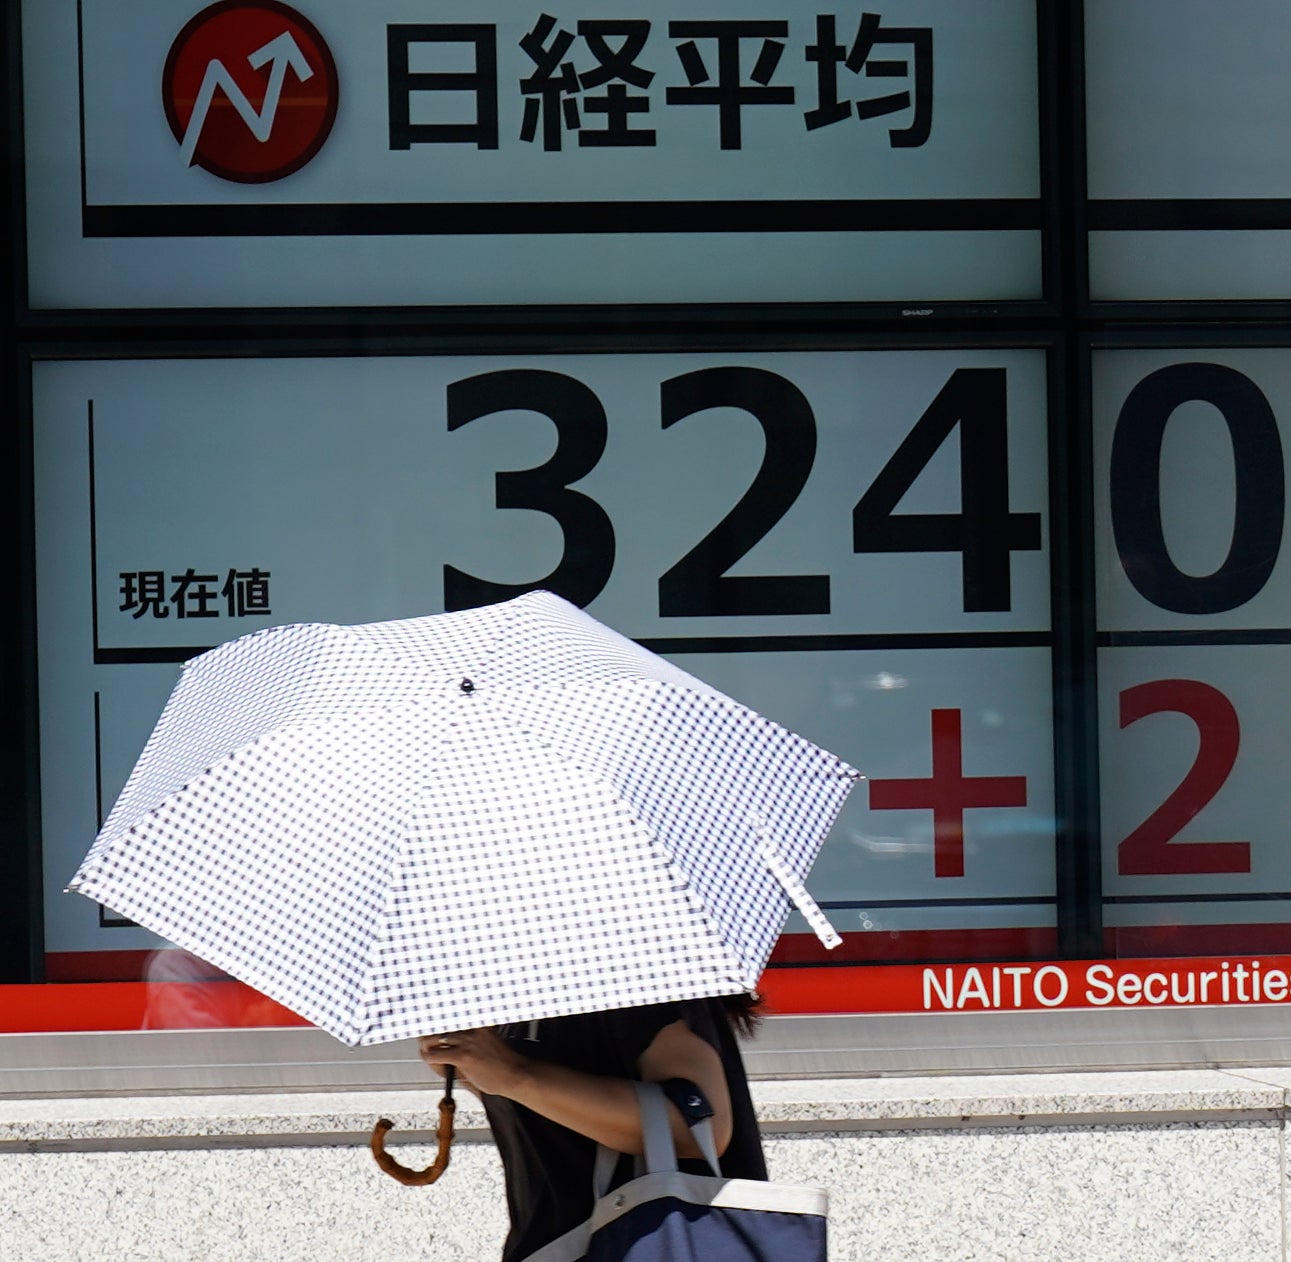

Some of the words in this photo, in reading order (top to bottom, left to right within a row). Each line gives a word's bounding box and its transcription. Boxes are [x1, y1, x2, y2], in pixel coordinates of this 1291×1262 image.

[387, 13, 934, 152] 日経平均
[118, 568, 272, 620] 現在値
[923, 965, 1068, 1009] NAITO
